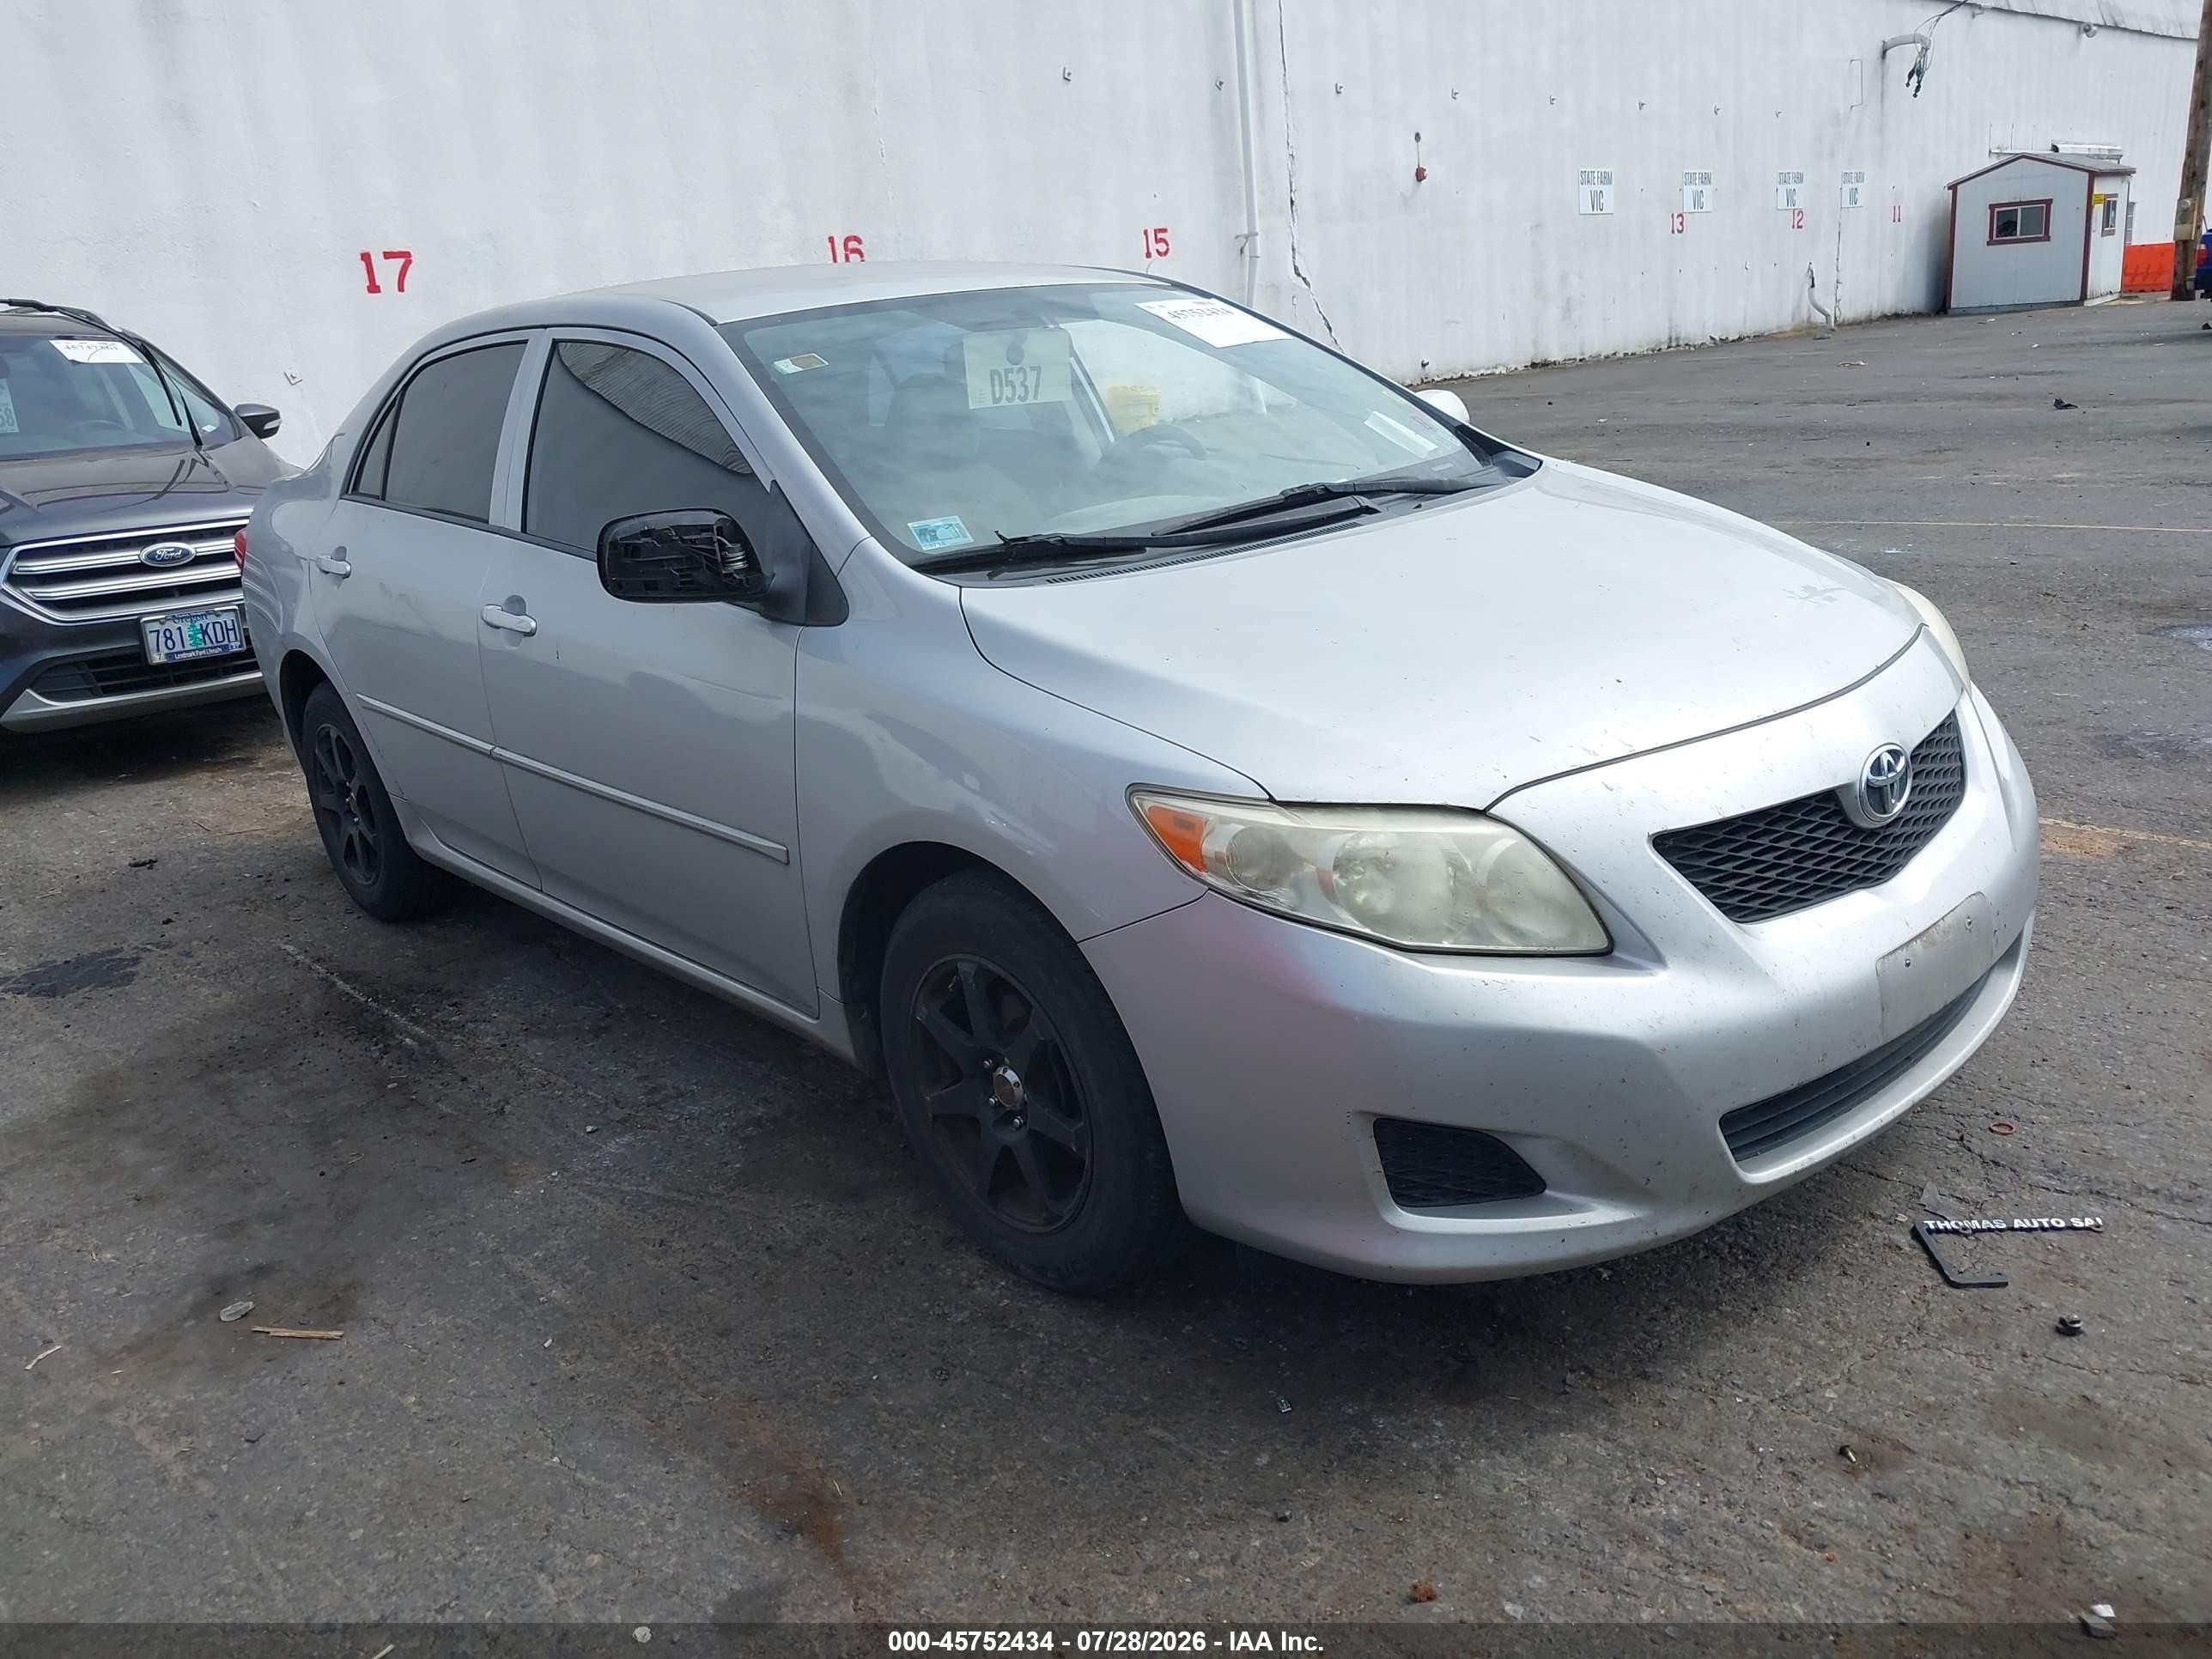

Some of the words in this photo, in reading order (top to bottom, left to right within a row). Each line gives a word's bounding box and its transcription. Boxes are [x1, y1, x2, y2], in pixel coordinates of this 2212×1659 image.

[1580, 171, 1595, 186] STATE
[1597, 171, 1613, 186] FARM
[1684, 172, 1697, 186] STATE
[1698, 172, 1711, 186] FARM
[1778, 172, 1791, 185] STATE
[1590, 190, 1604, 211] VIC
[1692, 190, 1704, 210] VIC
[1786, 188, 1796, 207] VIC
[1849, 187, 1858, 205] VIC
[1671, 213, 1685, 234] 13
[1792, 209, 1804, 229] 12
[1893, 205, 1901, 222] 11
[828, 234, 865, 264] 16
[1143, 228, 1170, 258] 15
[361, 250, 413, 294] 17
[989, 366, 1042, 404] D537
[155, 548, 182, 561] Ford
[149, 626, 185, 653] 781
[200, 618, 239, 646] KDH
[1923, 1218, 2007, 1230] THOMAS
[2013, 1218, 2065, 1229] AUTO
